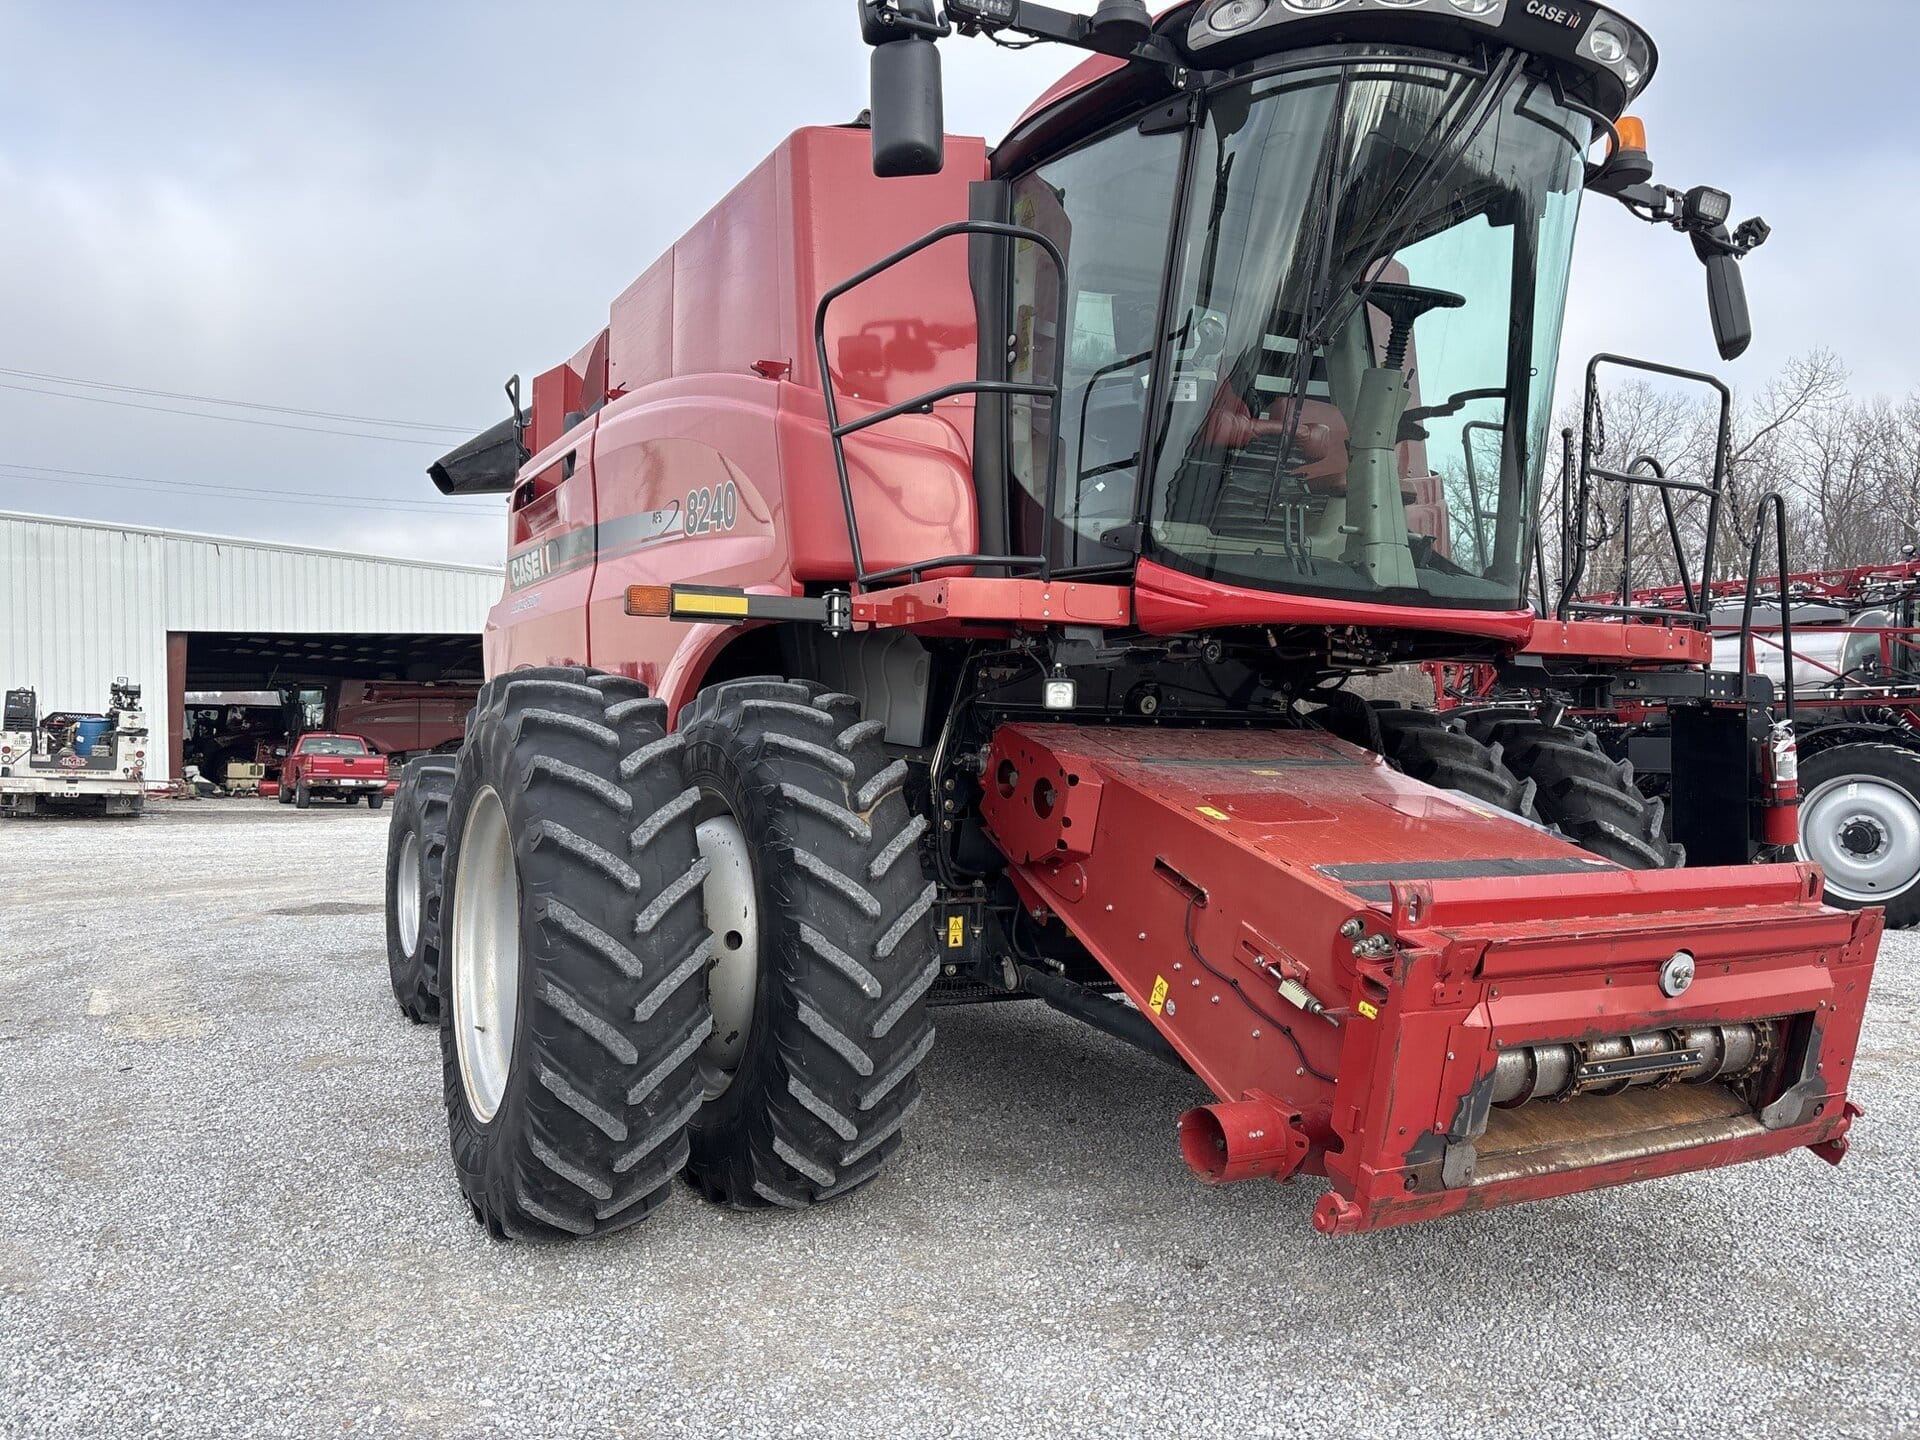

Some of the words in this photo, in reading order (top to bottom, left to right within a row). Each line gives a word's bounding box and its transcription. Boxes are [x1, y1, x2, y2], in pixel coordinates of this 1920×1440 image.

[1526, 0, 1567, 23] CASE
[685, 480, 737, 537] 8240
[511, 549, 541, 587] CASE
